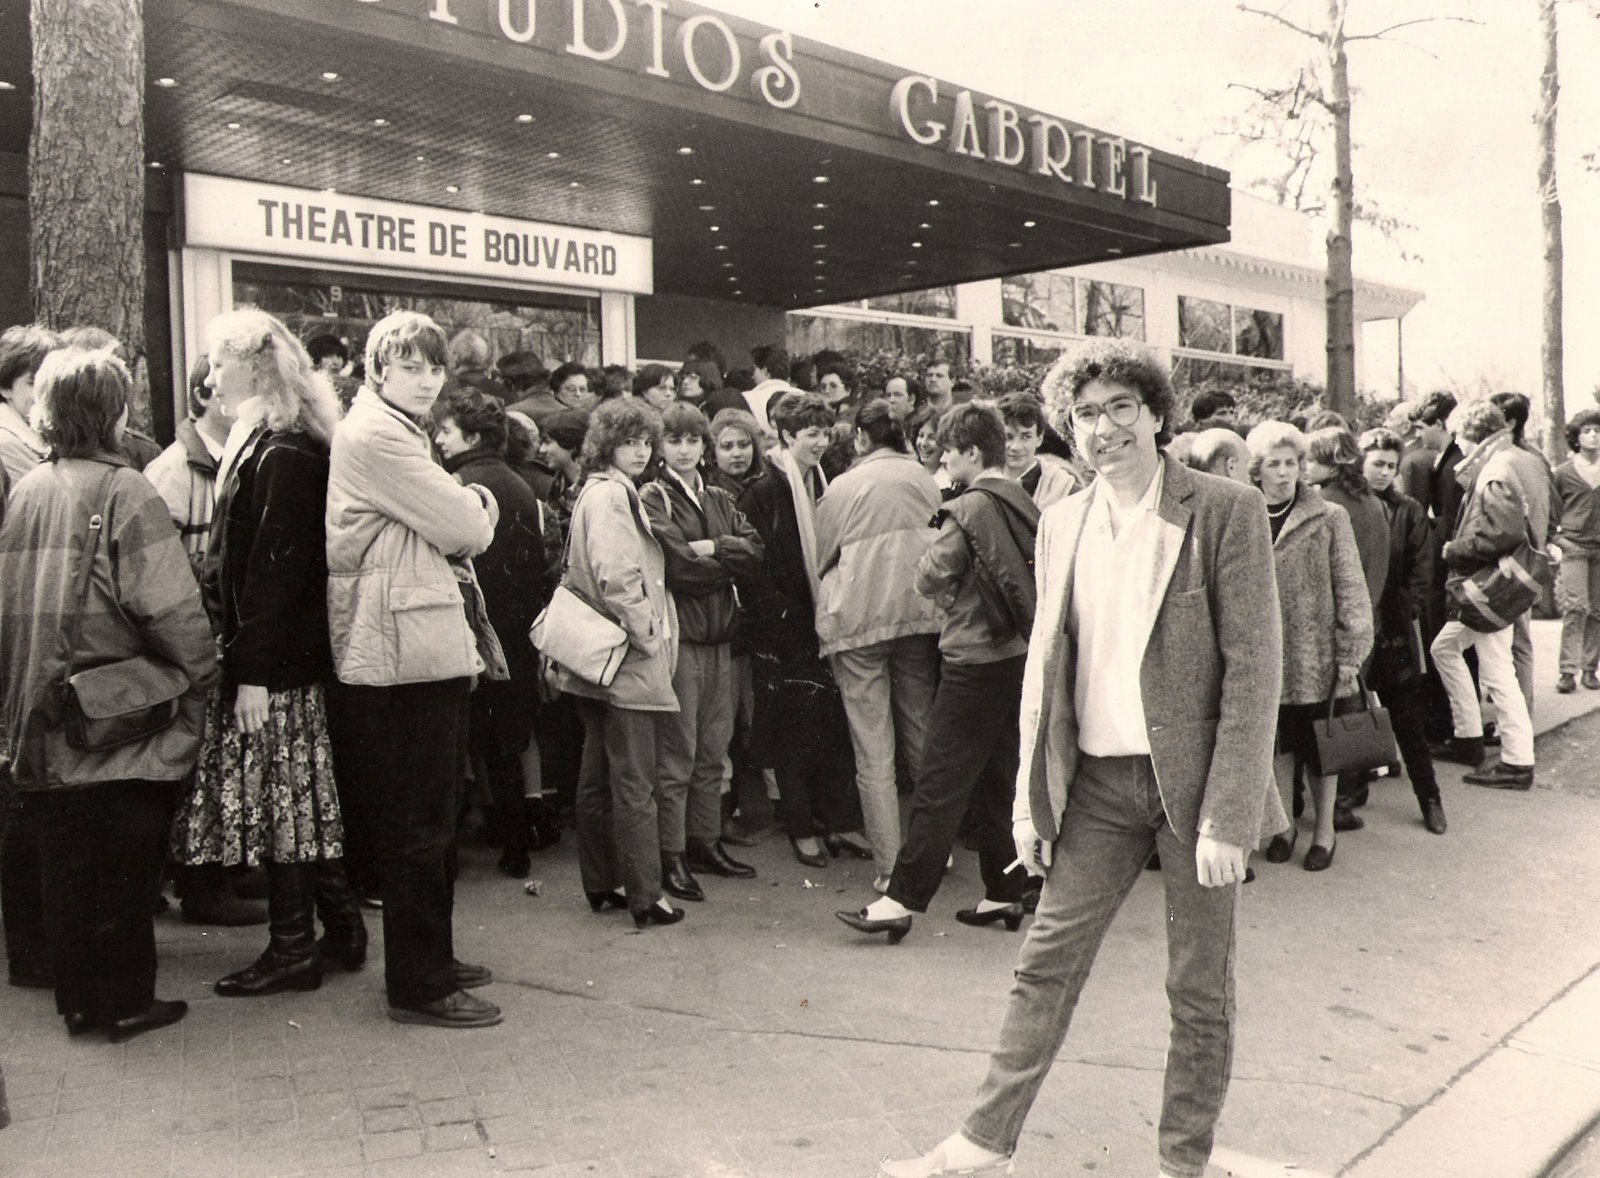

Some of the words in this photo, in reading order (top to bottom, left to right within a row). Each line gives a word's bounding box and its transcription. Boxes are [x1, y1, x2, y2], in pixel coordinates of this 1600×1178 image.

[357, 0, 801, 108] UDIOS
[890, 75, 1157, 208] GABRIEL
[258, 199, 416, 254] THEATRE
[428, 221, 467, 259] DE
[484, 229, 616, 276] BOUVARD
